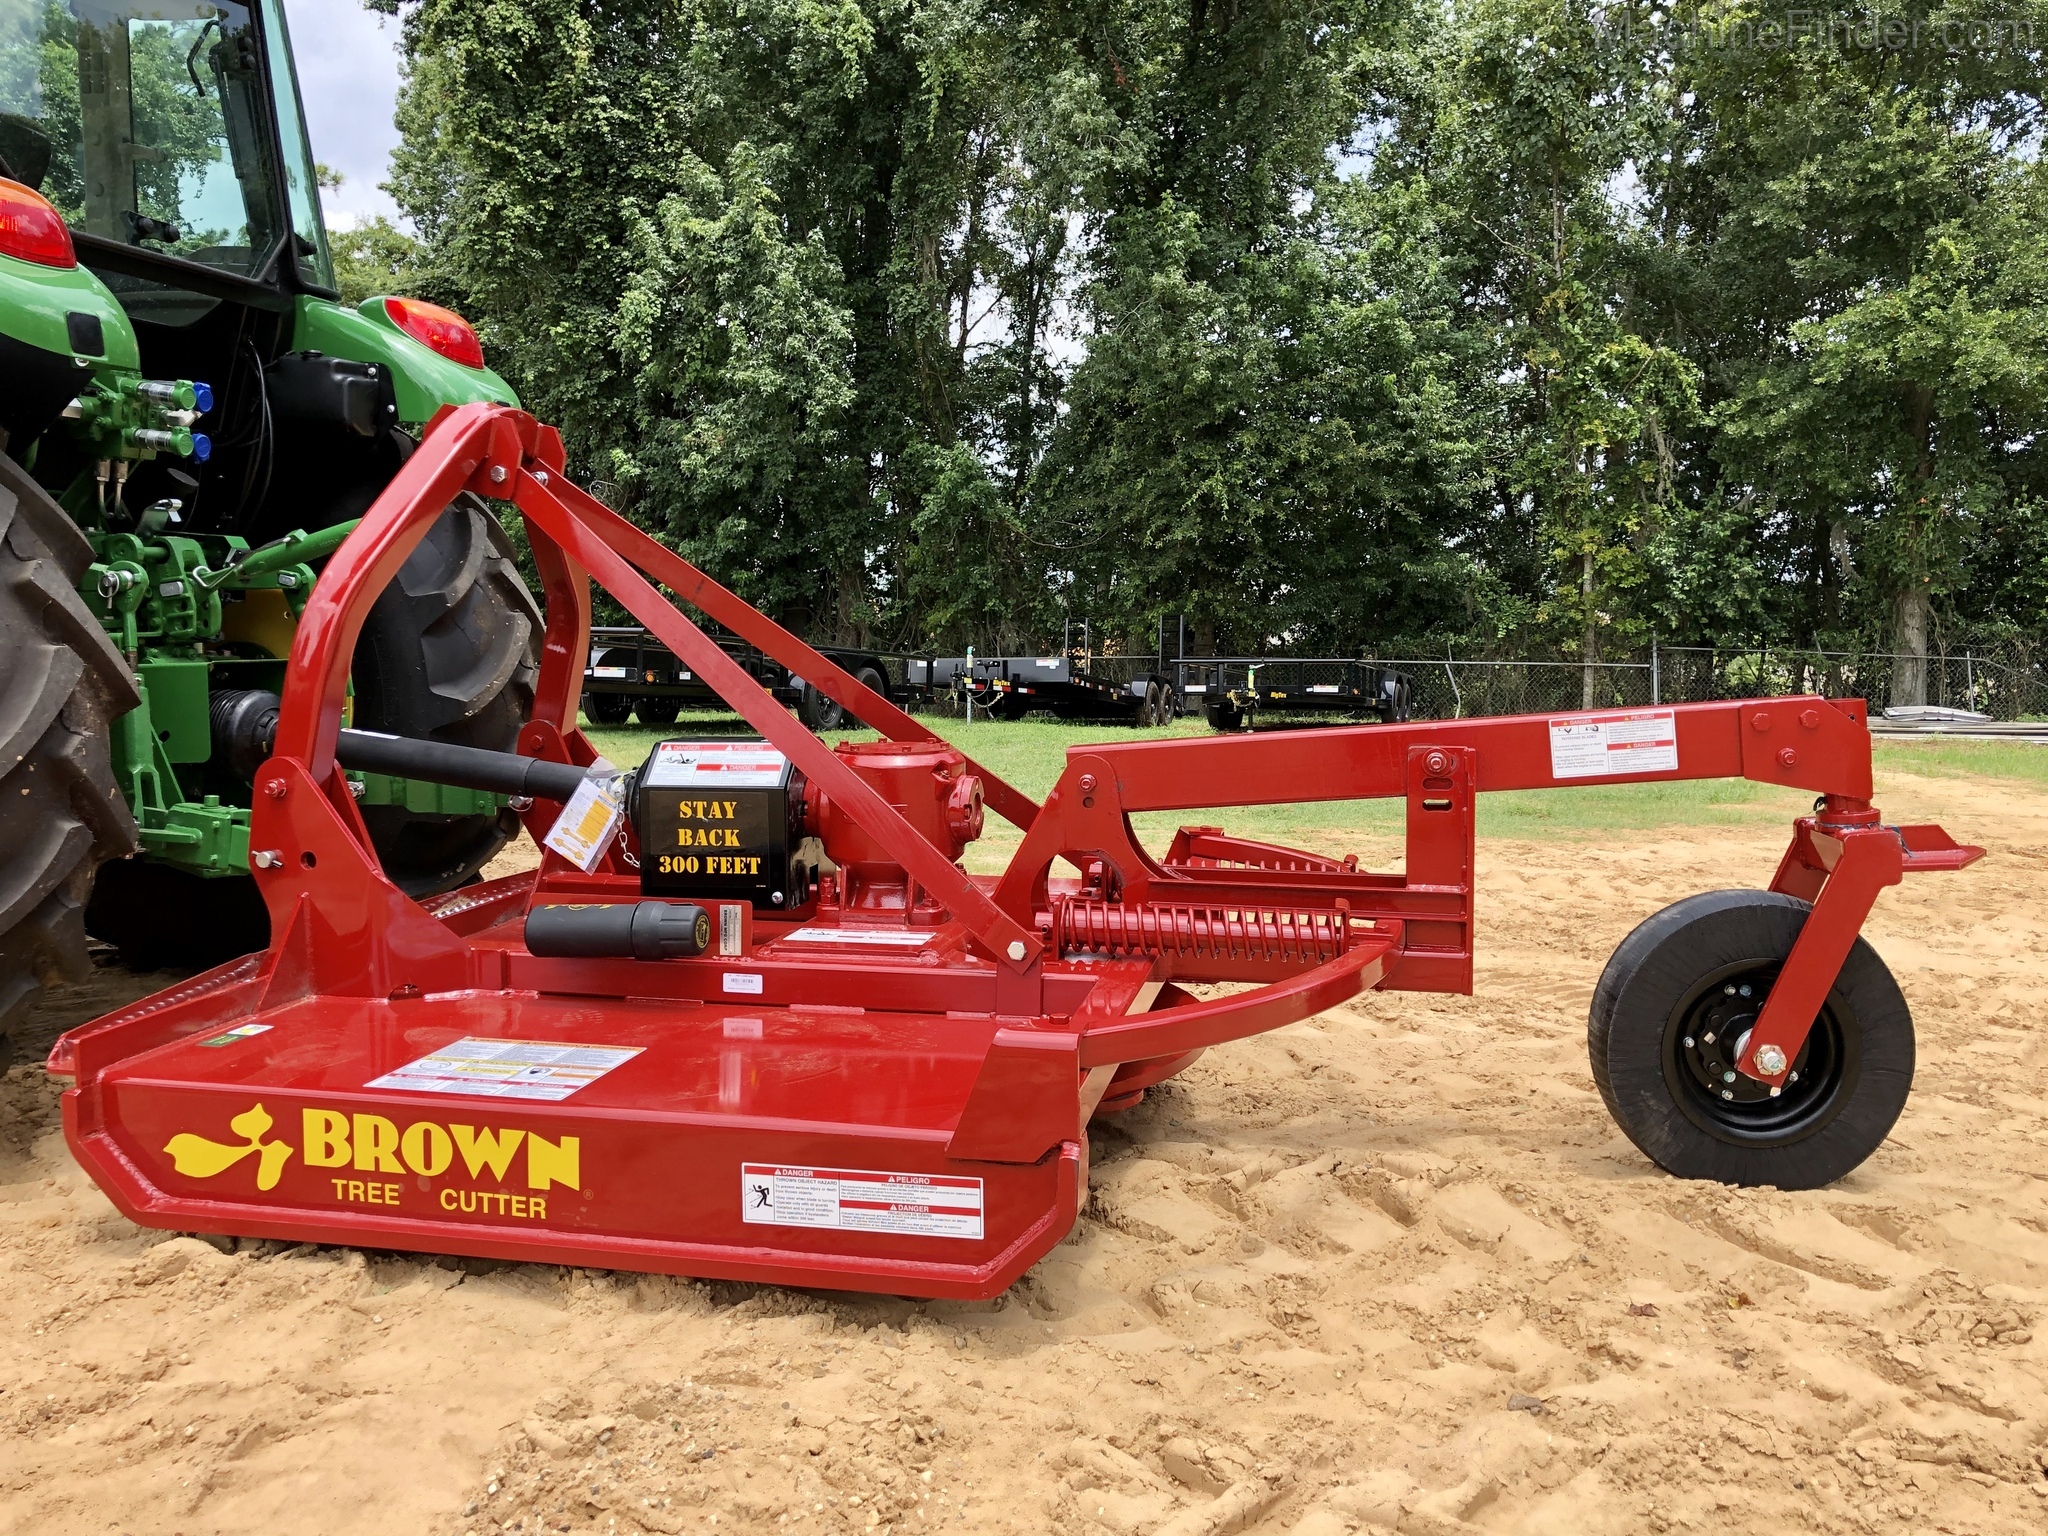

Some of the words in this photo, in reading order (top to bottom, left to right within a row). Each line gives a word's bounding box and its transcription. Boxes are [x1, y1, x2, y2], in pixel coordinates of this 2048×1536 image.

[679, 800, 738, 819] STAY
[677, 828, 741, 847] BACK
[659, 856, 699, 874] 300
[706, 856, 761, 875] FEET
[302, 1107, 580, 1192] BROWN
[782, 1169, 814, 1177] DANGER
[896, 1176, 930, 1184] PELIGRO
[332, 1178, 400, 1205] TREE
[440, 1188, 547, 1220] CUTTER
